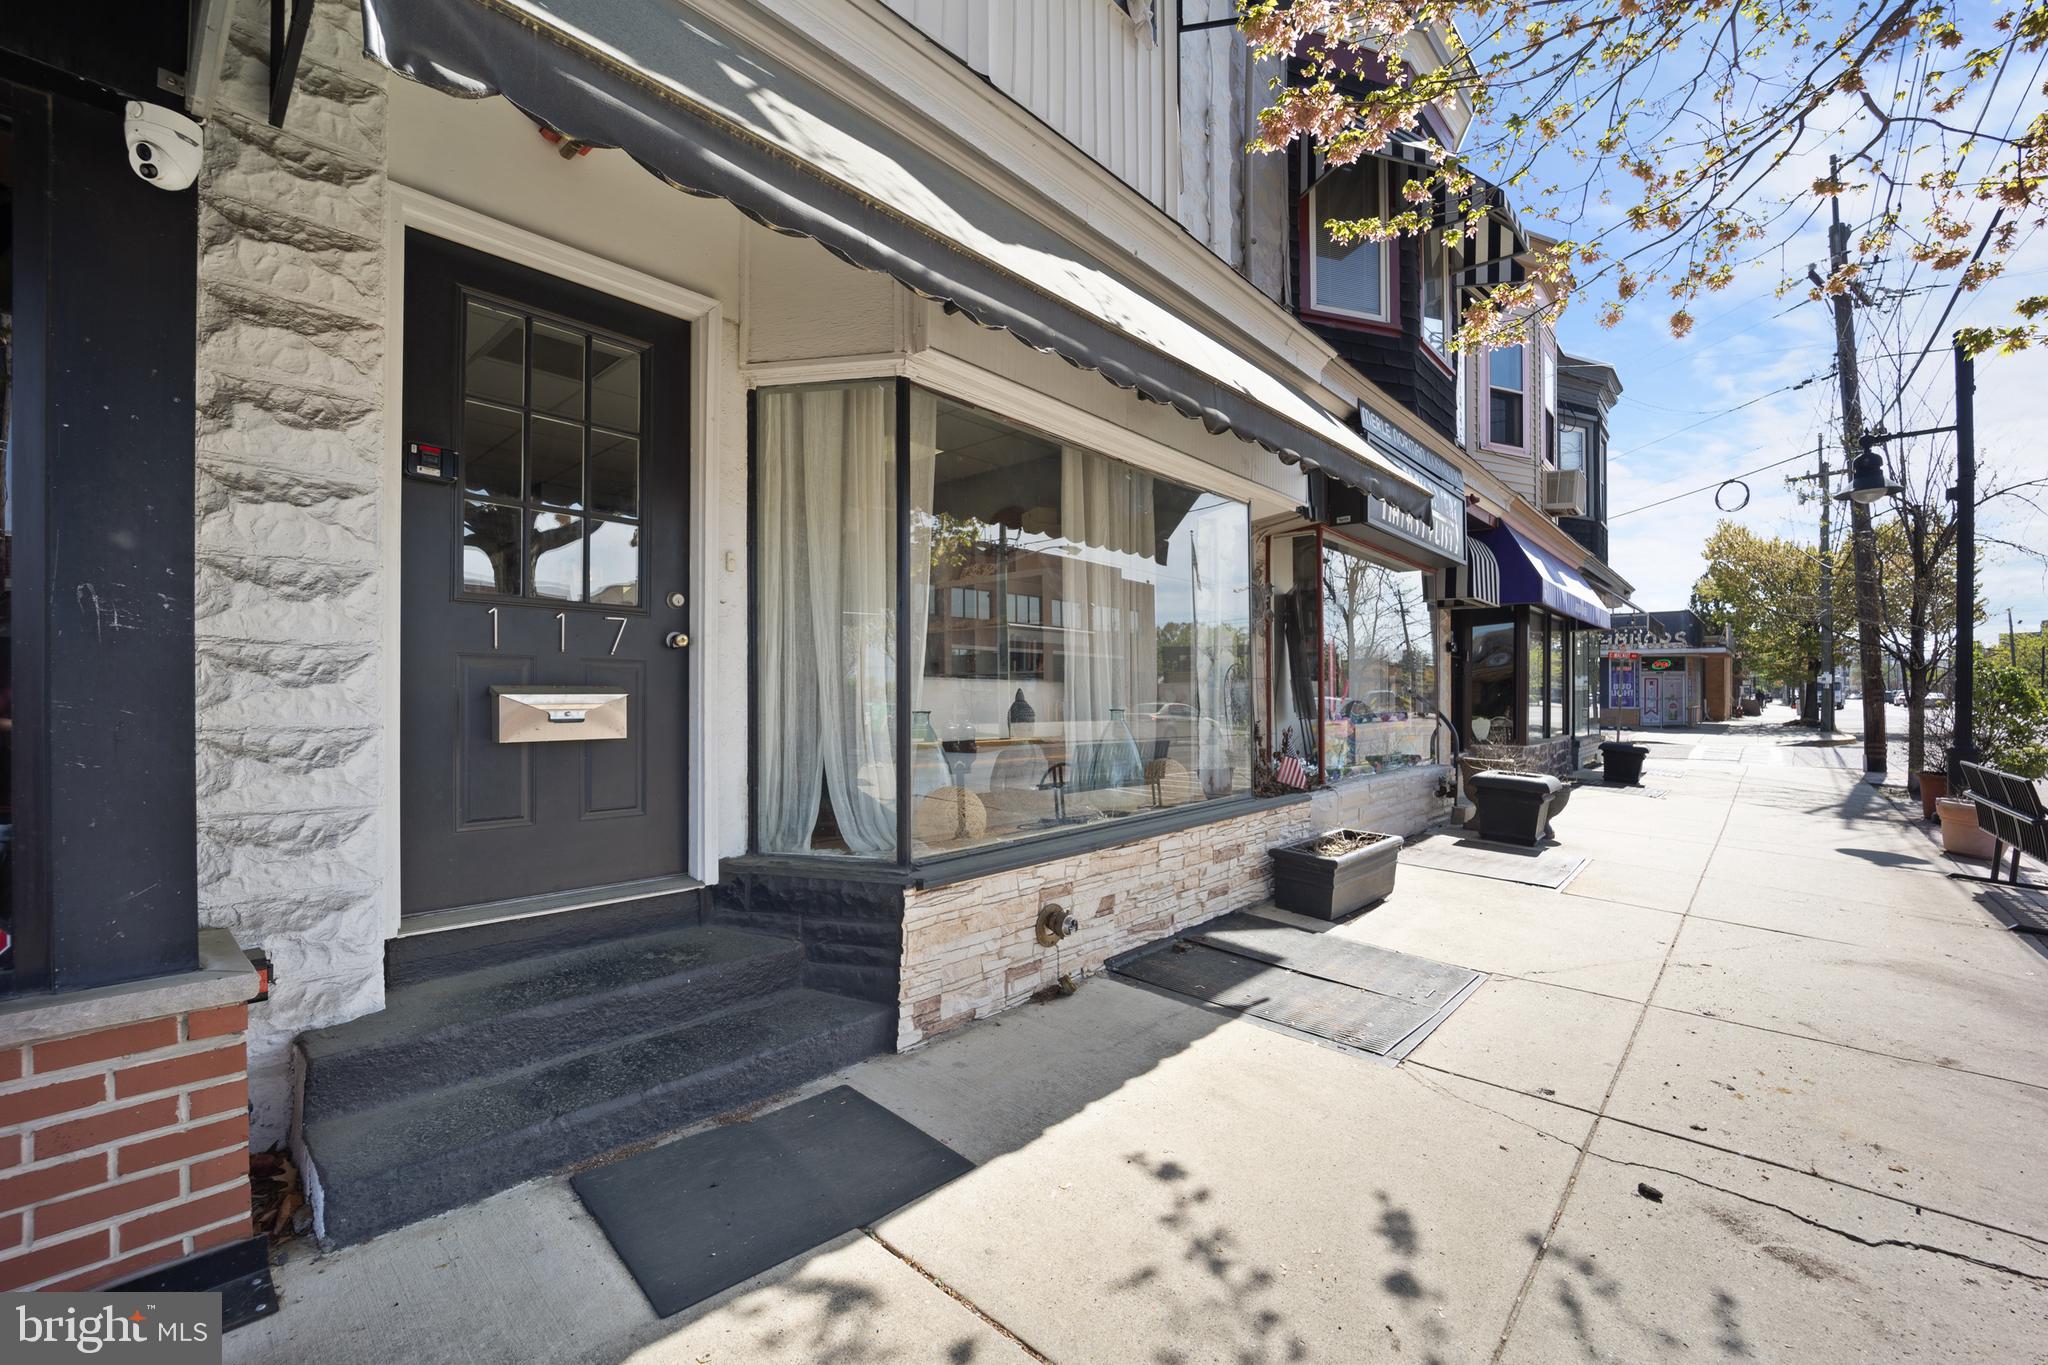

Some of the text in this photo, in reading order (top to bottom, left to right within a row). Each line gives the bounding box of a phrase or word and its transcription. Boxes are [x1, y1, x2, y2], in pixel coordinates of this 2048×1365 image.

[1361, 406, 1391, 439] MERLE
[1392, 428, 1425, 462] NORMAN
[488, 607, 627, 655] 117
